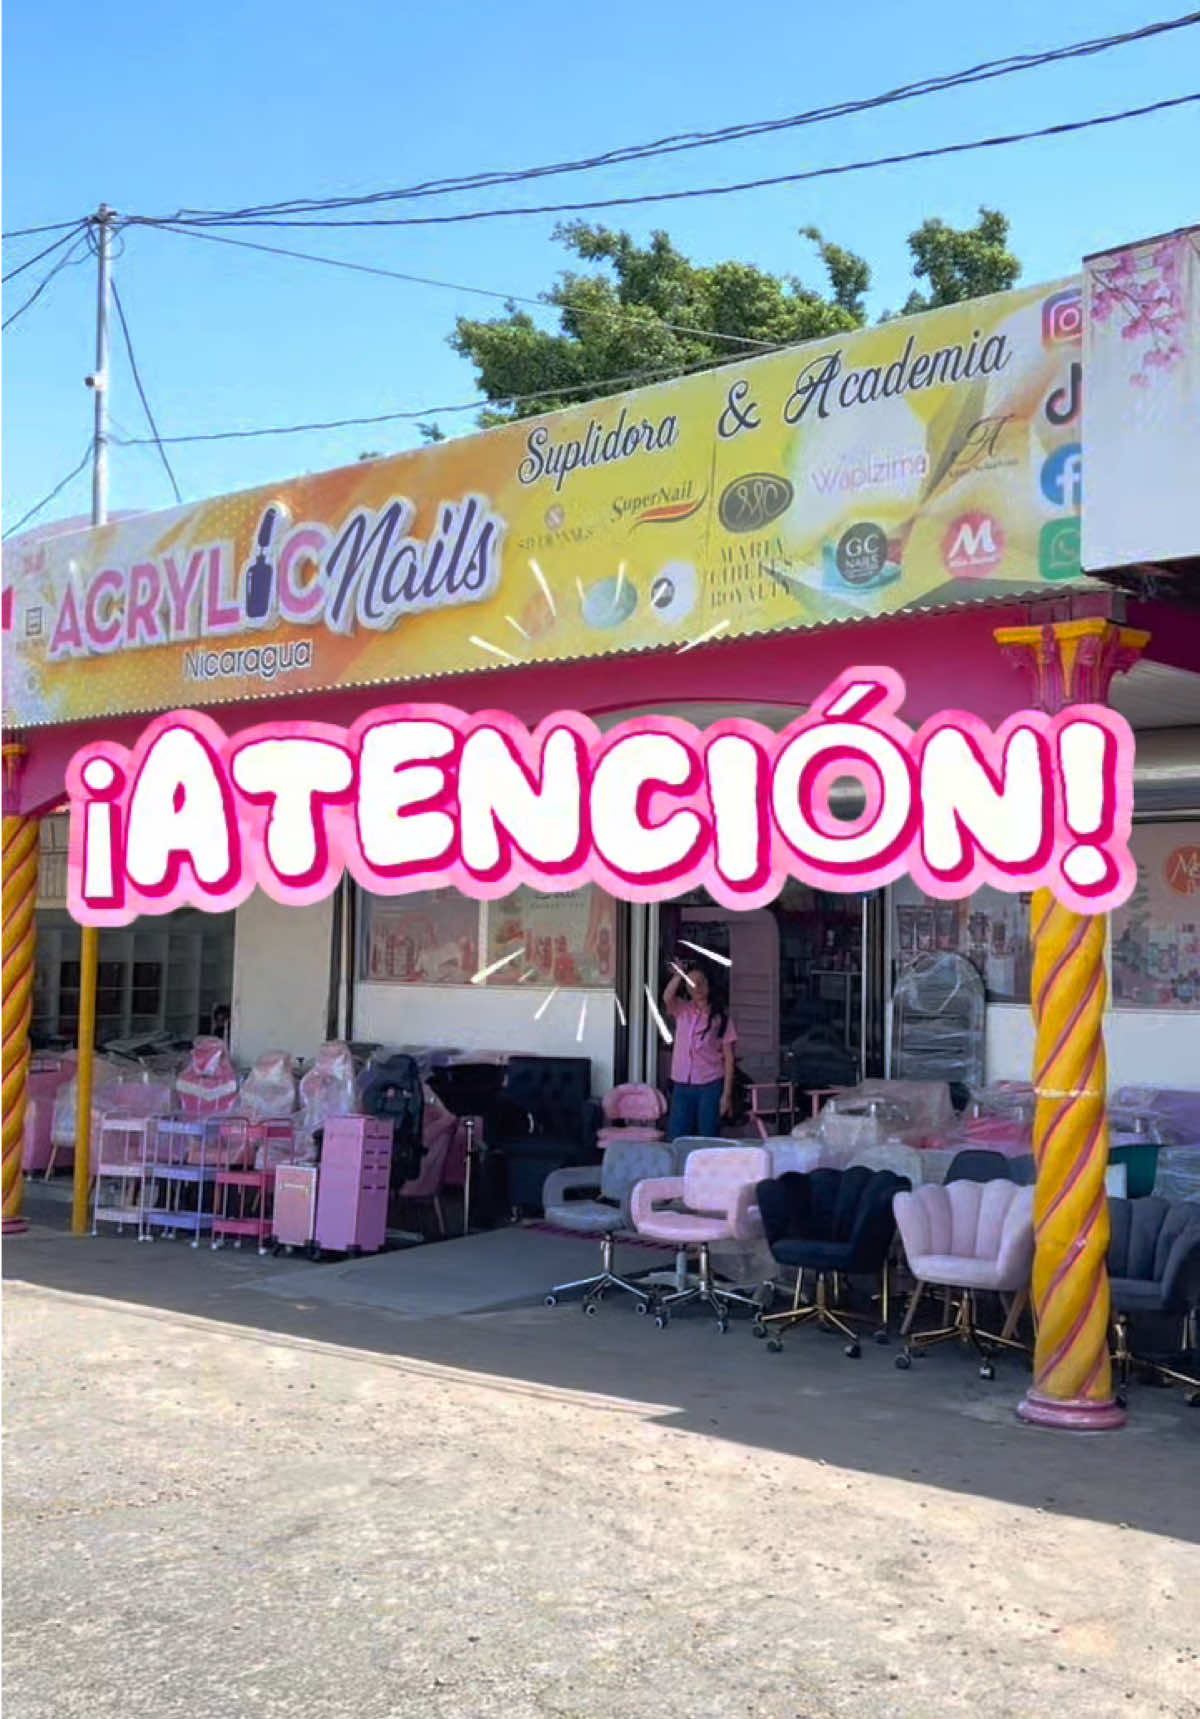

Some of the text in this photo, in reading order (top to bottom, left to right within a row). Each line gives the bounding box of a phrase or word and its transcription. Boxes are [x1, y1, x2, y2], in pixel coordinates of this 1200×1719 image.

[518, 330, 1012, 491] Suplidora & Academia
[326, 498, 494, 622] Nails
[185, 641, 312, 678] Nicaragua
